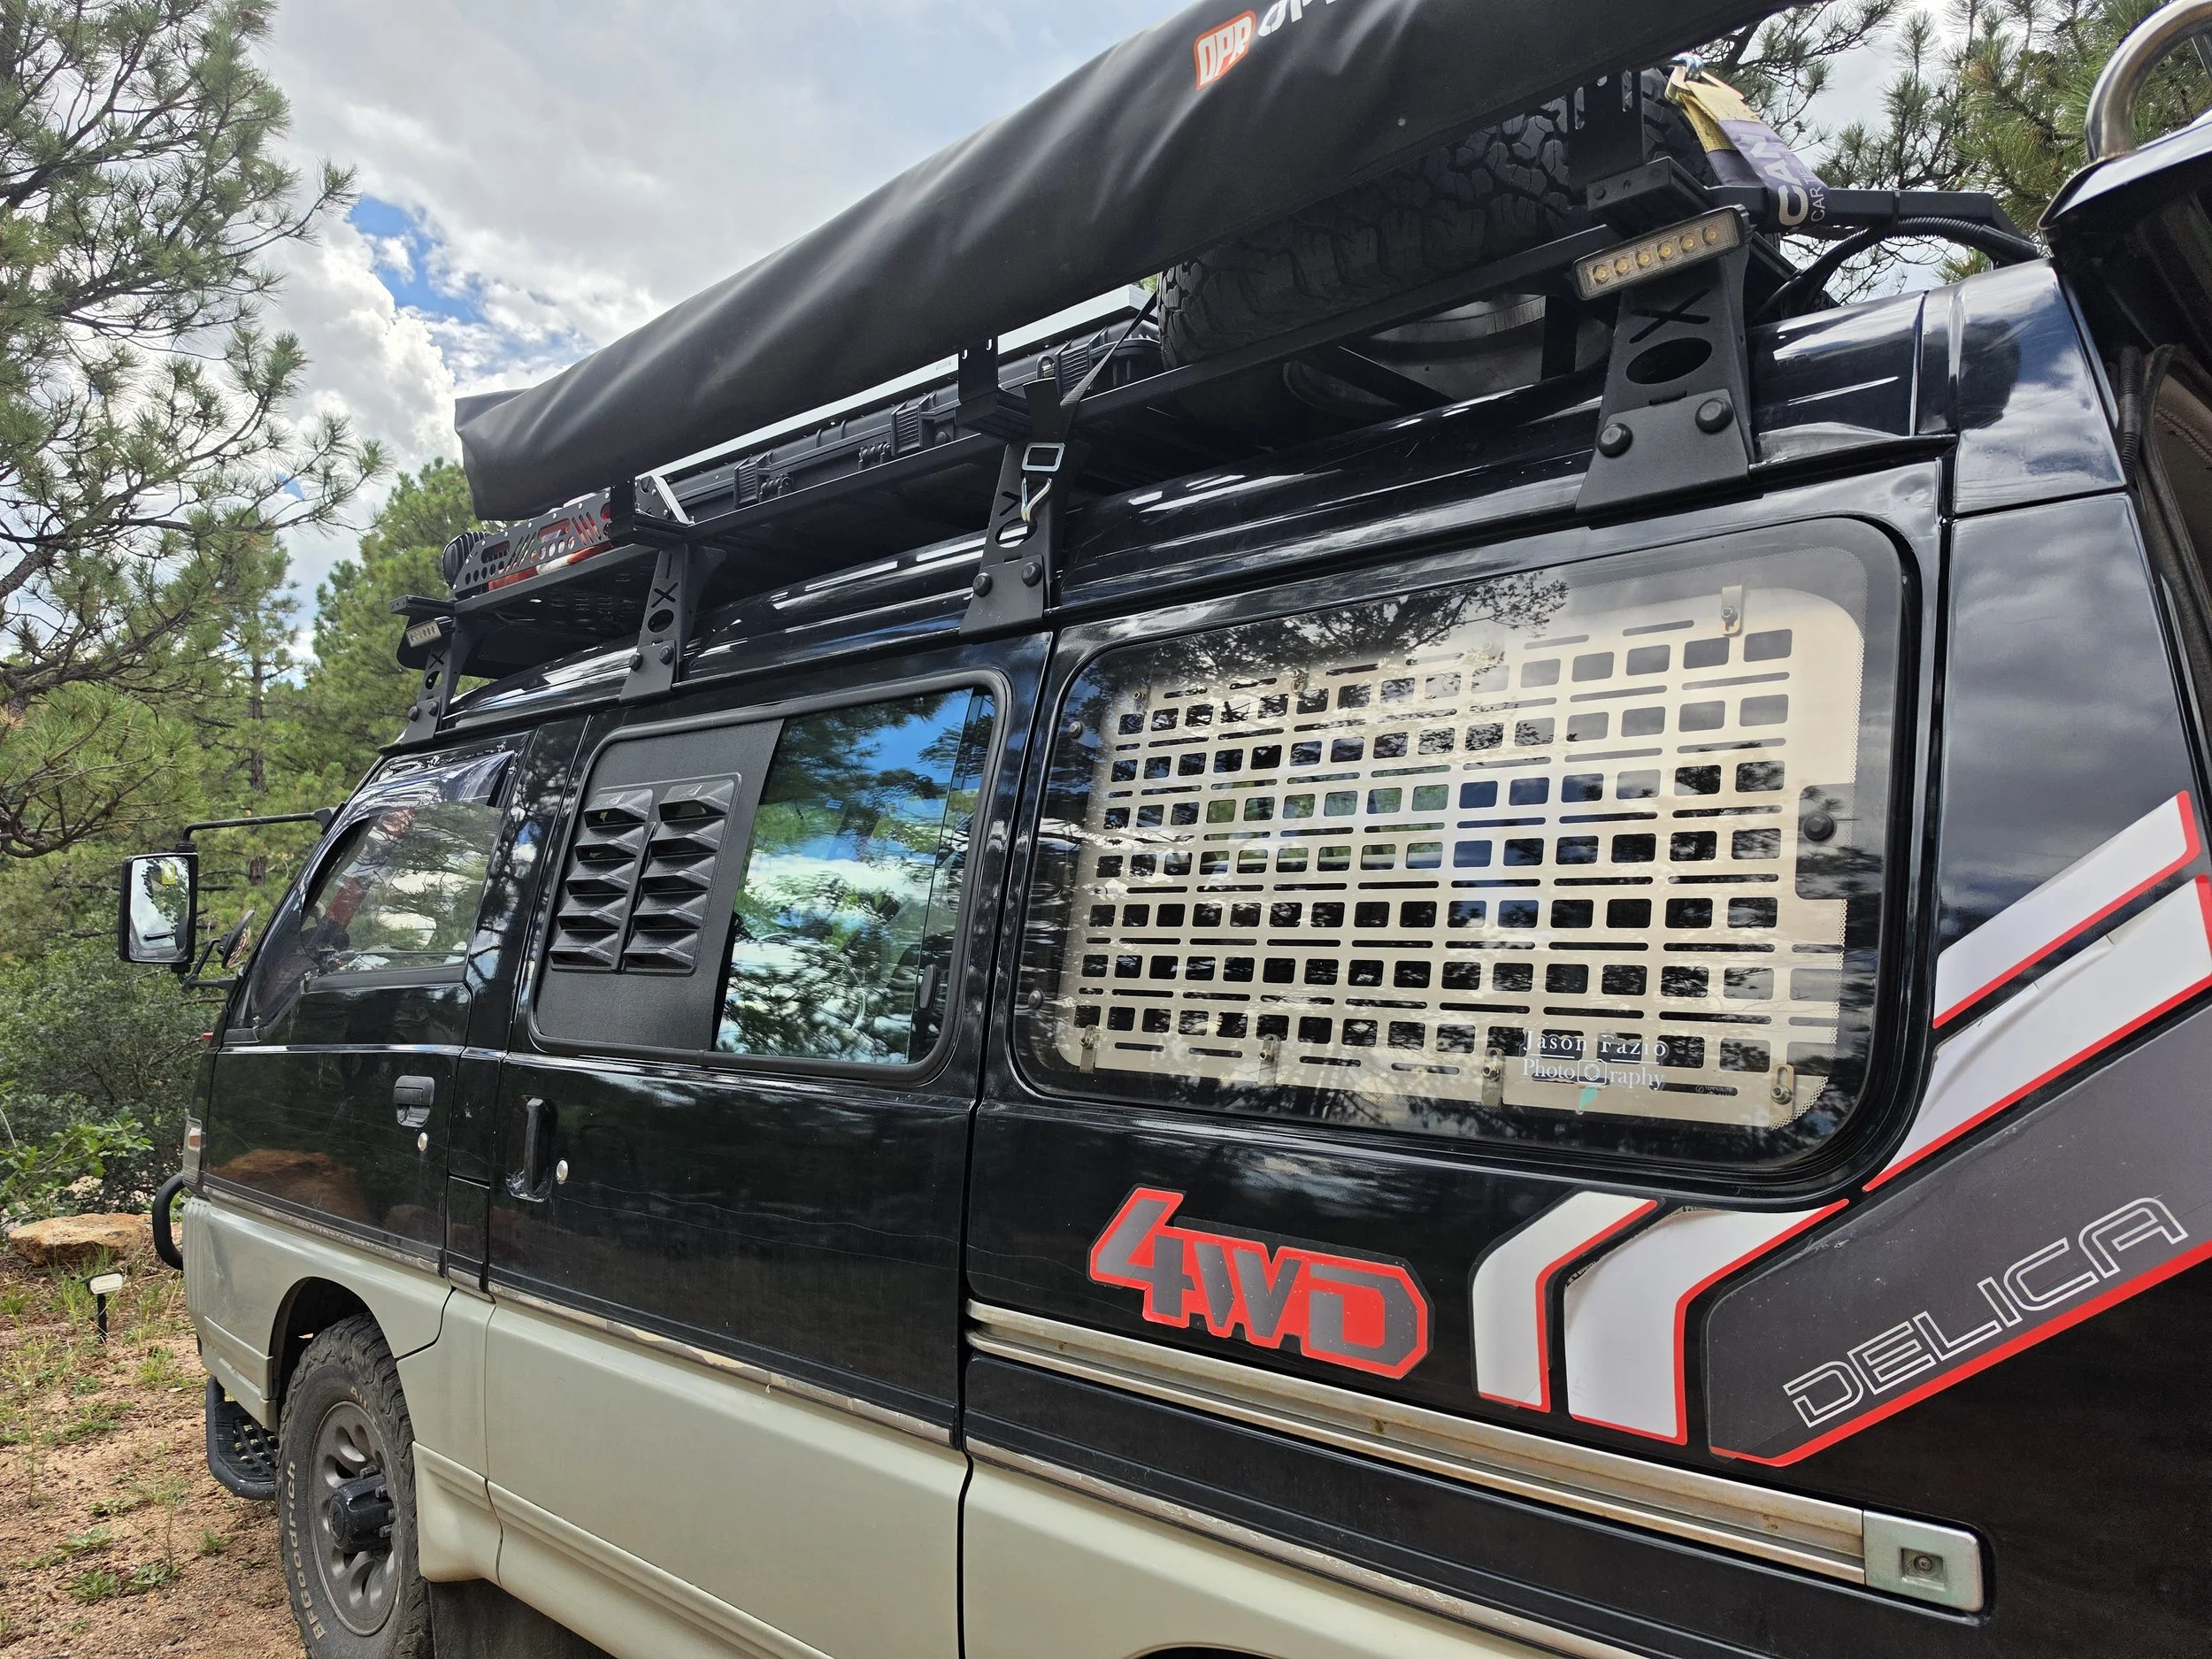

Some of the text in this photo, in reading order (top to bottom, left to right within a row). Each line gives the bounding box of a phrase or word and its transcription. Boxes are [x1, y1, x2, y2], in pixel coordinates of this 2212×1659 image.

[1810, 186, 1826, 223] CAR
[1523, 1029, 1588, 1052] Jason
[1093, 1191, 1424, 1375] 4WD
[1782, 1196, 2189, 1428] DELICA
